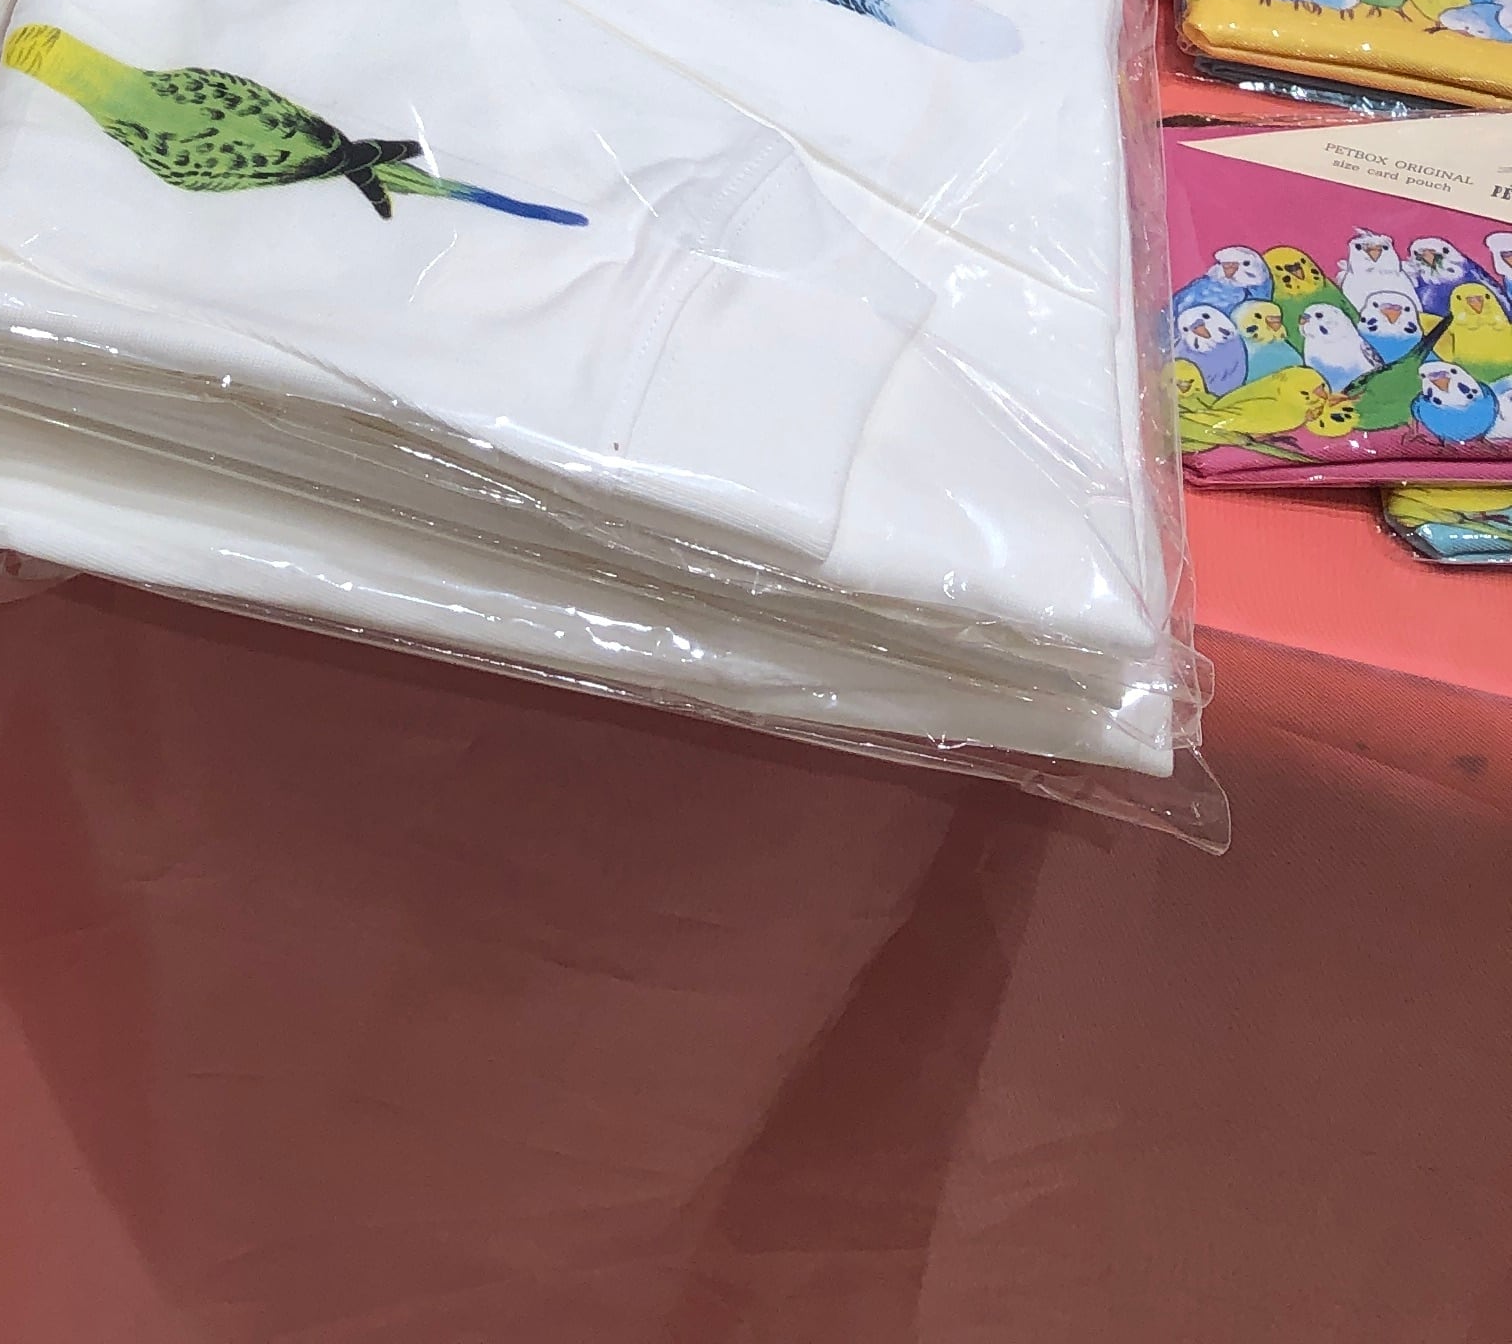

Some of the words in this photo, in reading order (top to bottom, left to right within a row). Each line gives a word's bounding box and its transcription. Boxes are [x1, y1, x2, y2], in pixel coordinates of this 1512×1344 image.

[1325, 142, 1388, 165] PETBOX
[1395, 160, 1474, 185] ORIGINAL
[1333, 158, 1360, 171] size
[1367, 168, 1399, 181] card
[1405, 175, 1452, 193] pouch
